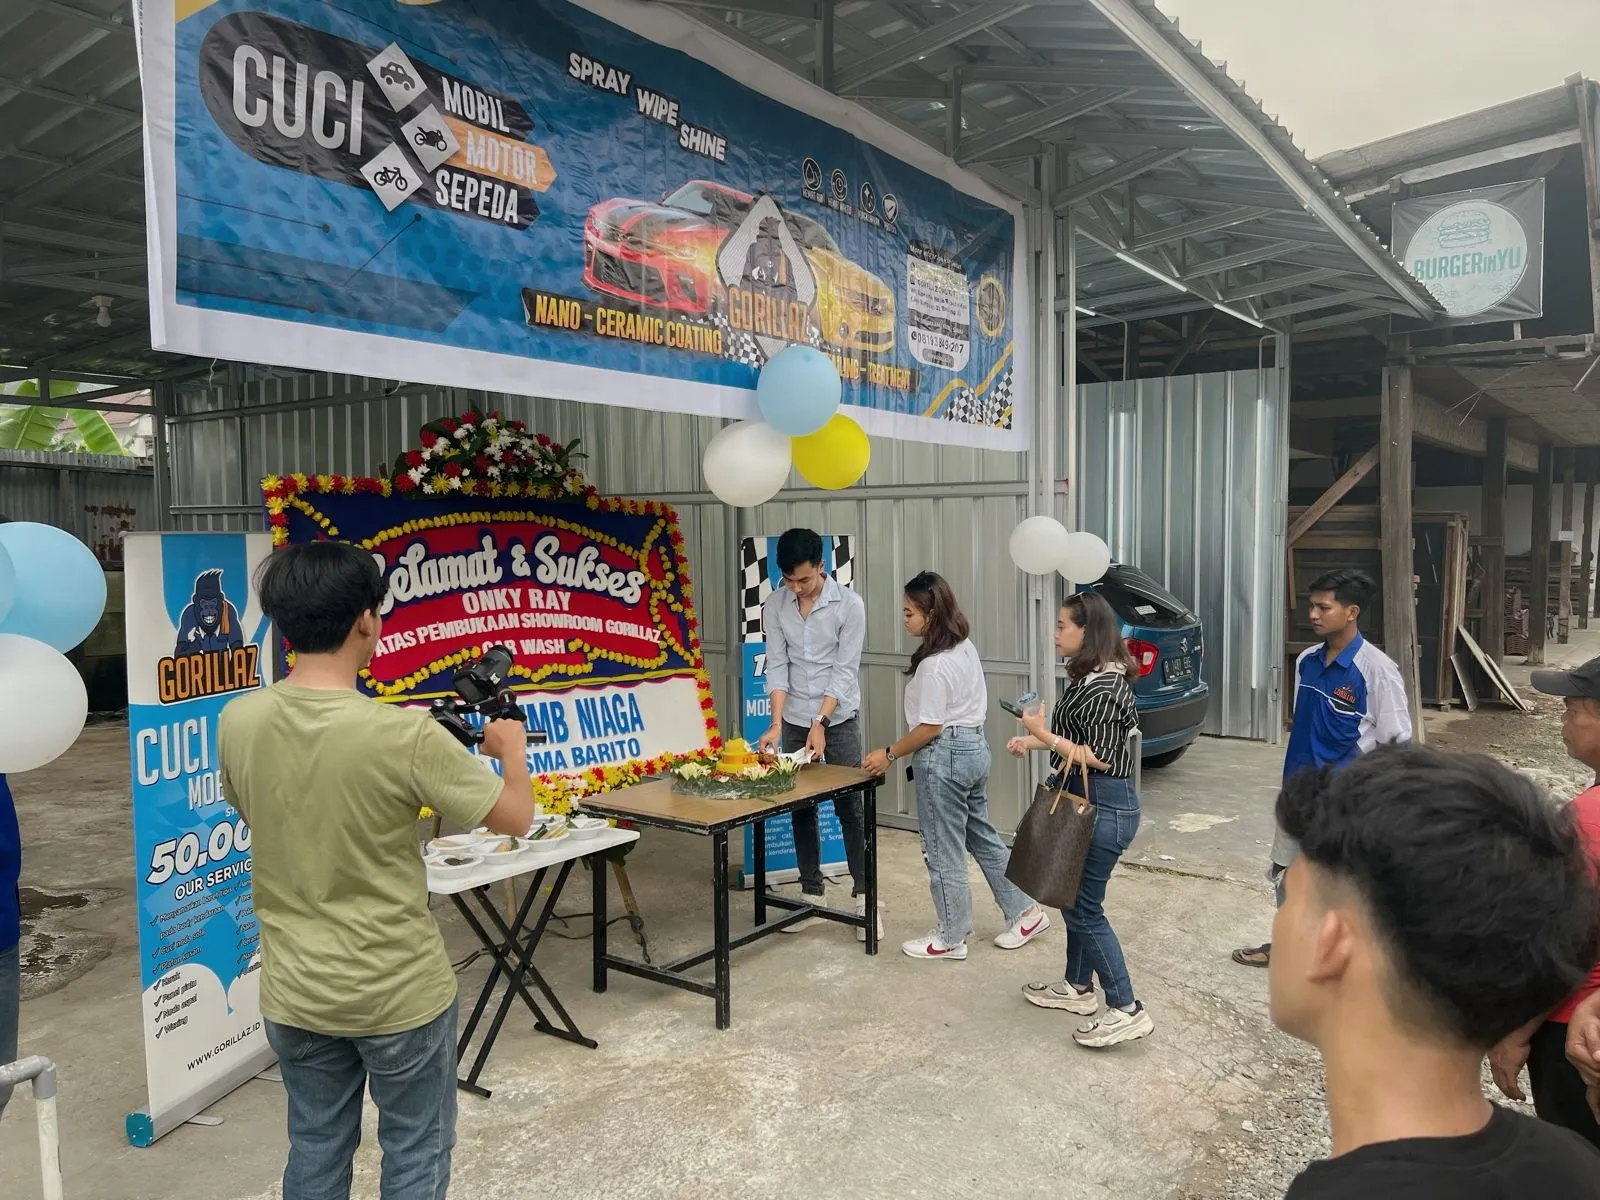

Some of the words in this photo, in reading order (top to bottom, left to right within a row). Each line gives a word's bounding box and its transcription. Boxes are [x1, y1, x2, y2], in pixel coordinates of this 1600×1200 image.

[569, 52, 631, 96] SPRAY
[231, 43, 364, 156] CUCI
[441, 76, 510, 134] MOBIL
[637, 88, 679, 128] WIPE
[466, 131, 538, 184] MOTOR
[679, 123, 727, 161] SHINE
[435, 169, 519, 224] SEPEDA
[535, 294, 581, 331] NANO
[595, 309, 664, 346] CERAMIC
[666, 320, 722, 355] COATING
[729, 287, 809, 342] GORILLAZ
[868, 361, 912, 390] TREATMENT
[511, 544, 531, 577] &
[534, 535, 646, 604] Sukses
[463, 588, 523, 615] ONKY
[529, 589, 572, 611] RAY
[375, 630, 417, 657] ATAS
[418, 613, 521, 646] PEMBUKAAN
[521, 611, 605, 632] SHOWROOM
[605, 619, 662, 643] GORILLAZ
[520, 639, 566, 656] WASH
[160, 646, 260, 703] GORILLAZ
[519, 700, 569, 746] IMB
[577, 692, 646, 738] NIAGA
[746, 699, 771, 717] MOB
[136, 716, 210, 786] CUCI
[526, 750, 568, 779] SMA
[572, 737, 641, 769] BARITO
[188, 770, 224, 810] MOB
[146, 818, 252, 884] 50.00
[769, 848, 796, 856] kendaraa
[175, 877, 204, 900] OUR
[206, 857, 252, 888] SERVIC
[187, 1021, 261, 1071] WWW.GORILLAZ.ID
